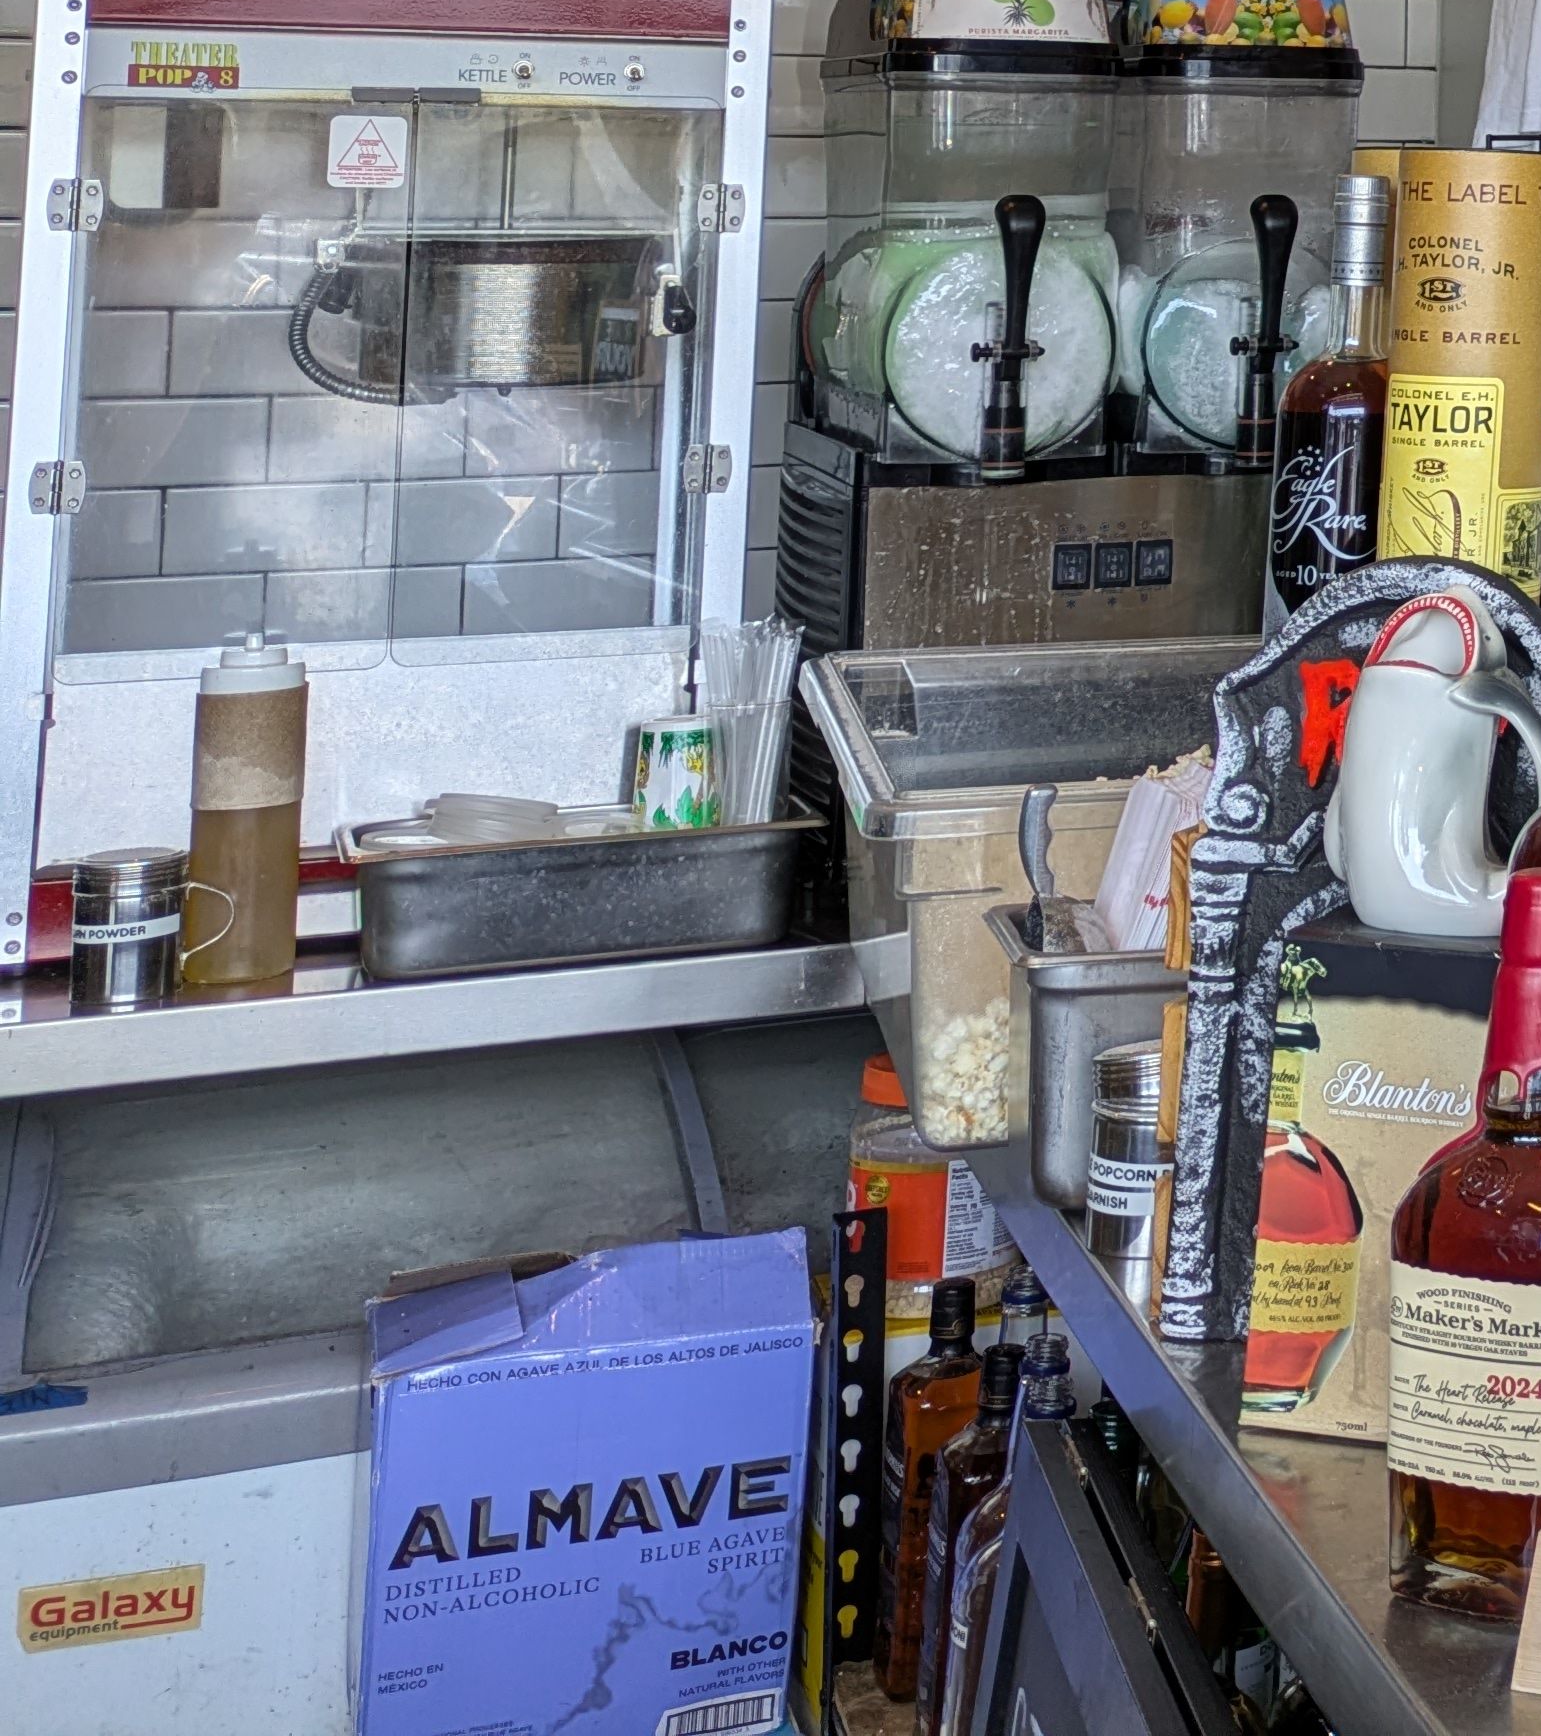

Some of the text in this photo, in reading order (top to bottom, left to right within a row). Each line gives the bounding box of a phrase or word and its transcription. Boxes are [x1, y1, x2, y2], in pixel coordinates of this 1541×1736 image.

[131, 41, 240, 65] THEATER
[137, 67, 616, 87] POP 8 KETTLE POWER
[1402, 181, 1527, 205] THE LABEL
[1408, 236, 1484, 252] COLONEL
[1492, 261, 1519, 280] JR.
[1443, 331, 1521, 345] BARREL
[1391, 388, 1454, 401] COLONEL
[1391, 402, 1493, 434] TAYLOR
[1391, 436, 1485, 448] SINGLE BARREL
[1296, 565, 1317, 585] 10
[87, 923, 146, 940] POWDER
[1323, 1060, 1472, 1117] Blanton's
[1093, 1164, 1156, 1182] POPCORN
[1416, 1288, 1512, 1314] WOOD FINISHING
[1405, 1302, 1484, 1332] Maker's
[407, 1337, 803, 1392] HECHO CON AGAVE DE LOS ALTOS DE JALISCO
[1436, 1380, 1469, 1403] Heart
[1336, 1421, 1368, 1432] 750ml
[387, 1455, 791, 1570] ALMAVE
[640, 1526, 785, 1564] BLUE AGAVE
[707, 1547, 785, 1575] SPIRIT
[385, 1567, 521, 1602] DISTILLED
[30, 1584, 197, 1628] Galaxy
[383, 1576, 600, 1624] NON-ALCOHOLIC
[29, 1618, 119, 1644] equipment
[670, 1630, 788, 1670] BLANCO
[378, 1663, 443, 1682] HECHO EN
[717, 1656, 786, 1678] WITH OTHER
[678, 1668, 785, 1698] NATURAL FLAVORS
